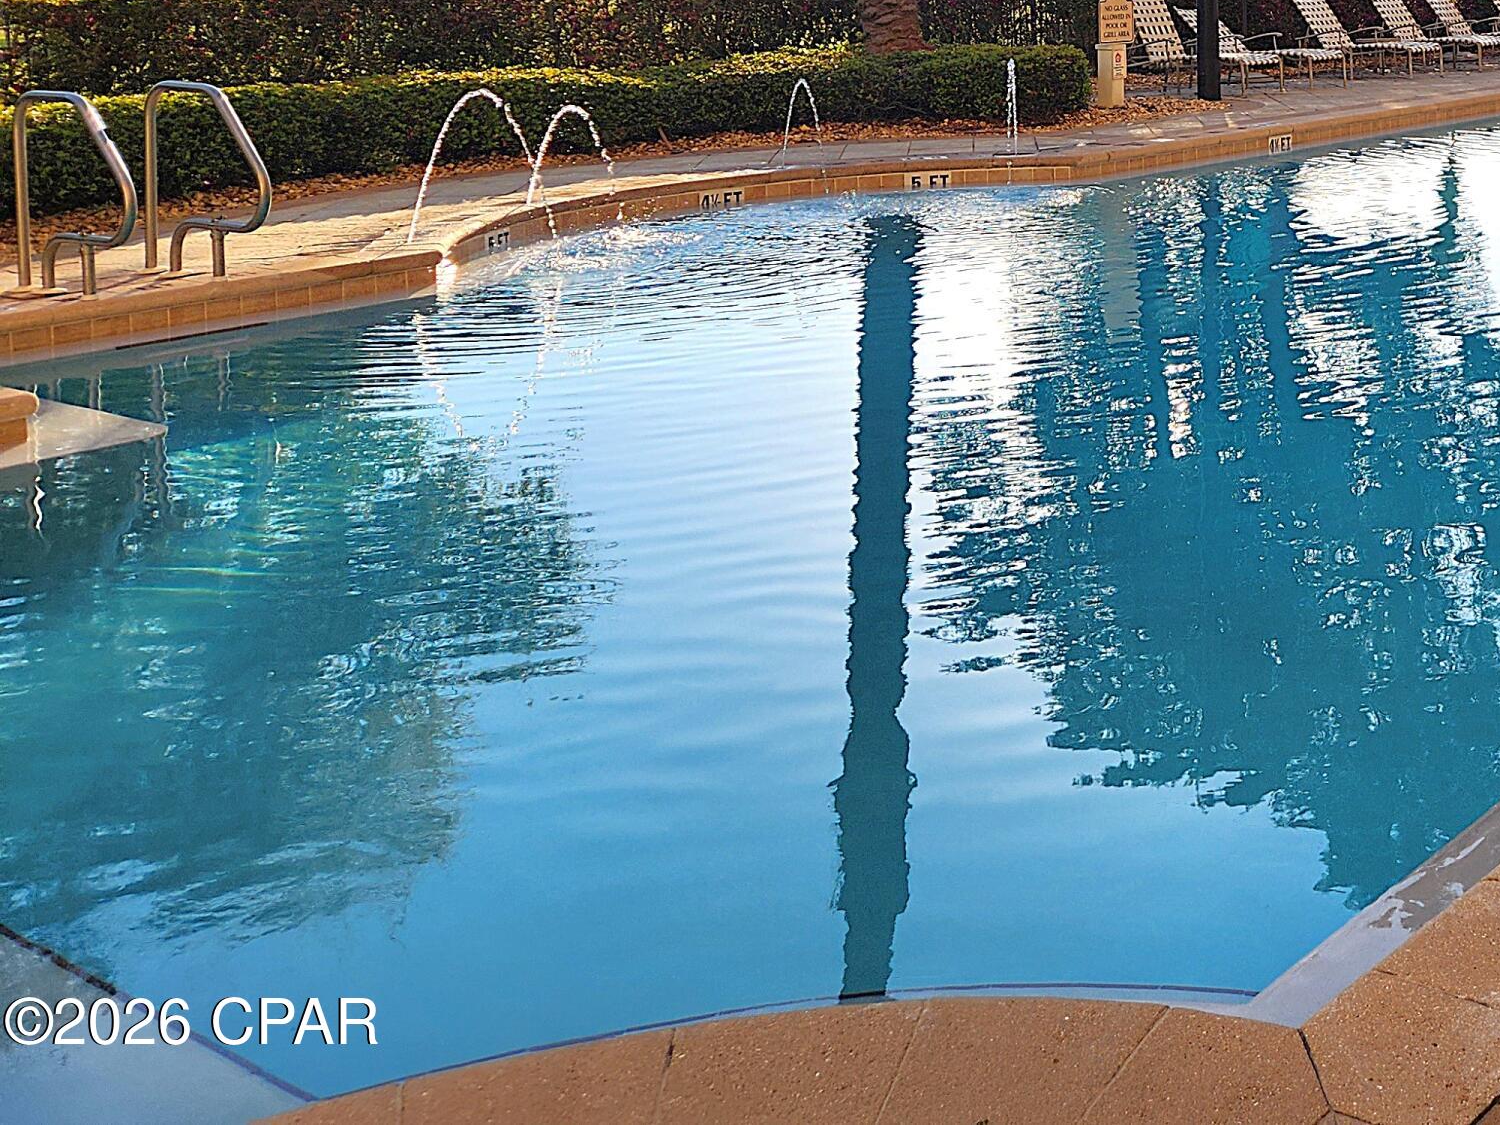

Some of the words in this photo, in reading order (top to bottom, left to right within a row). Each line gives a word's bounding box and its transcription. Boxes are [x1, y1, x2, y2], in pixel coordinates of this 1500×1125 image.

[911, 175, 921, 188] 5
[929, 174, 949, 188] FT
[723, 190, 743, 205] FT
